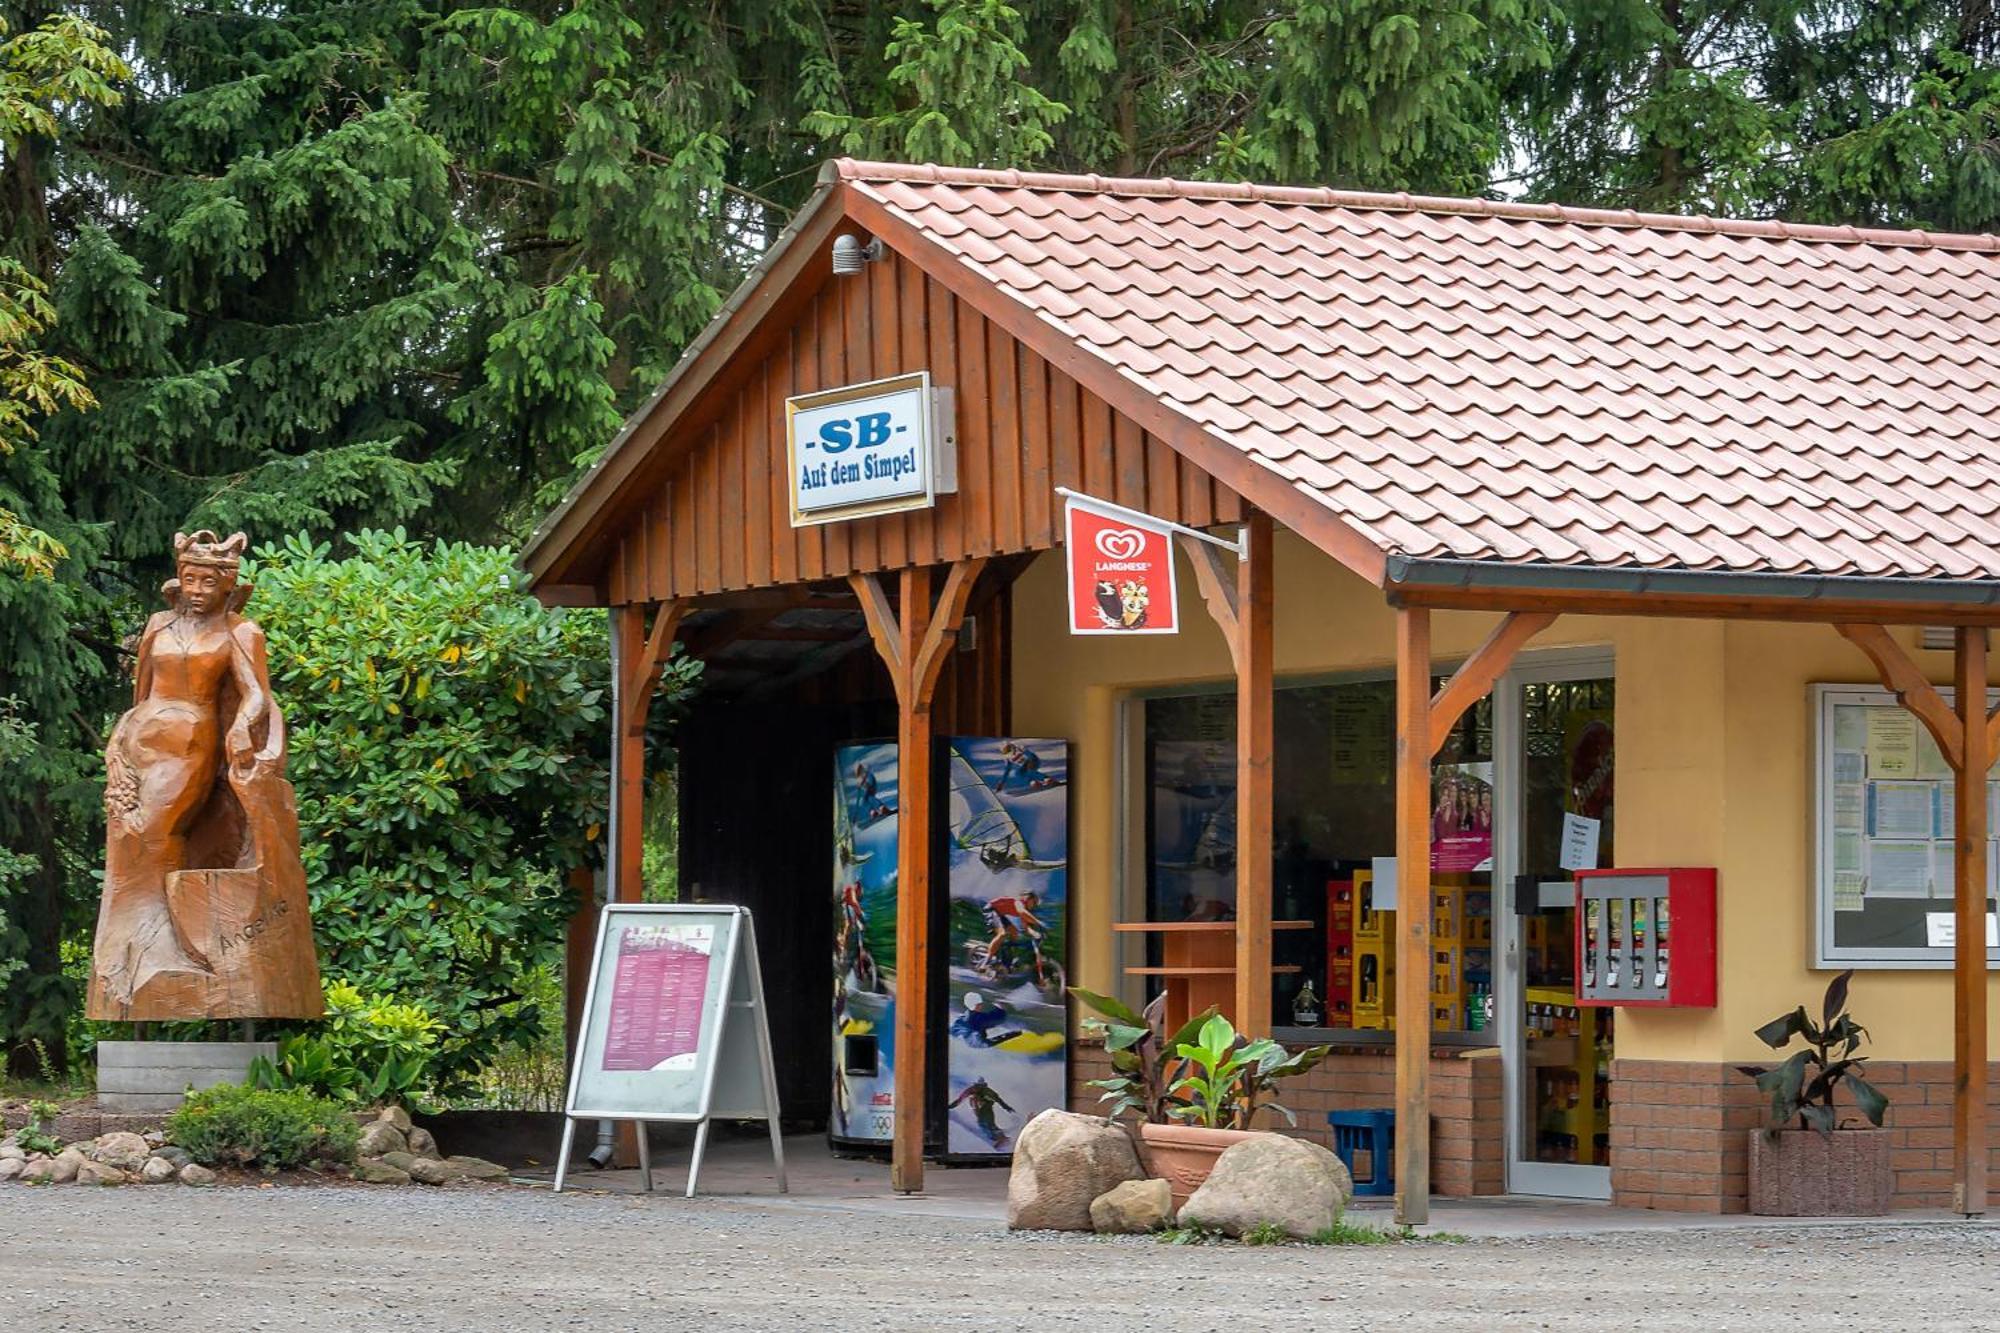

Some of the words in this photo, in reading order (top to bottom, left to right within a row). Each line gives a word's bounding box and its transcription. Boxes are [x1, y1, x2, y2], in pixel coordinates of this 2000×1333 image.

[801, 462, 827, 490] Auf
[831, 460, 860, 486] dem
[864, 447, 916, 481] Simpel
[1095, 562, 1148, 572] LANGNESE
